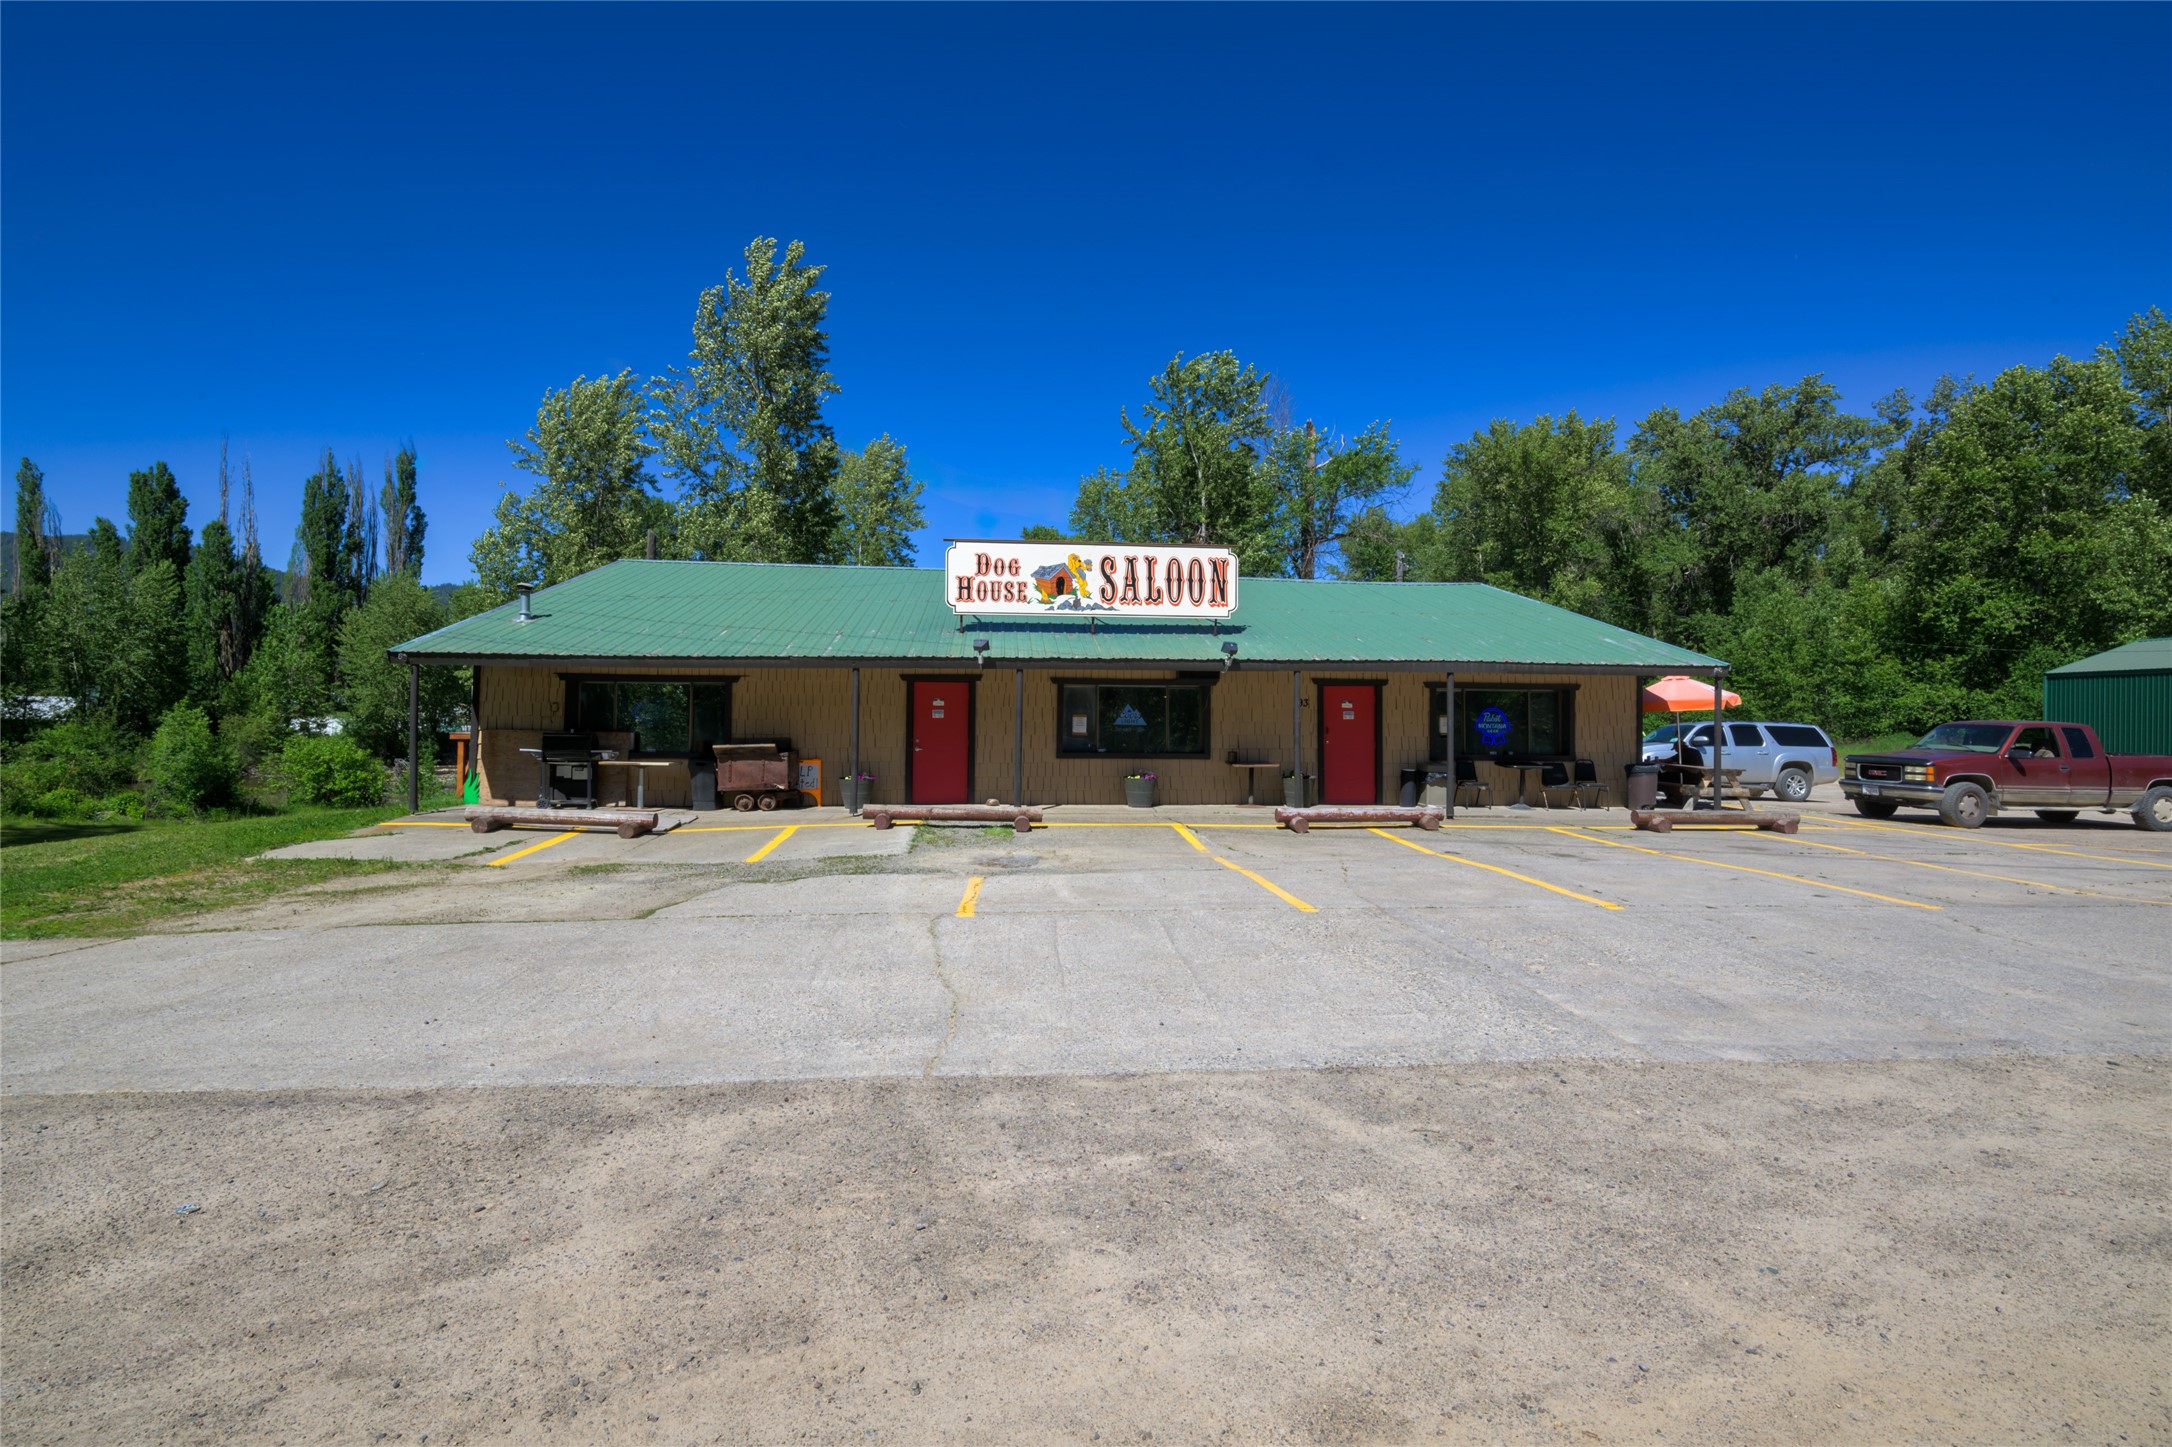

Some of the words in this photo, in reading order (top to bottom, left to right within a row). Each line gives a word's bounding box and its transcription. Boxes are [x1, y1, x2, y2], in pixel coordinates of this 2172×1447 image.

[975, 553, 1021, 577] DOG
[955, 576, 1028, 603] HOUSE
[1100, 555, 1229, 607] SALOON
